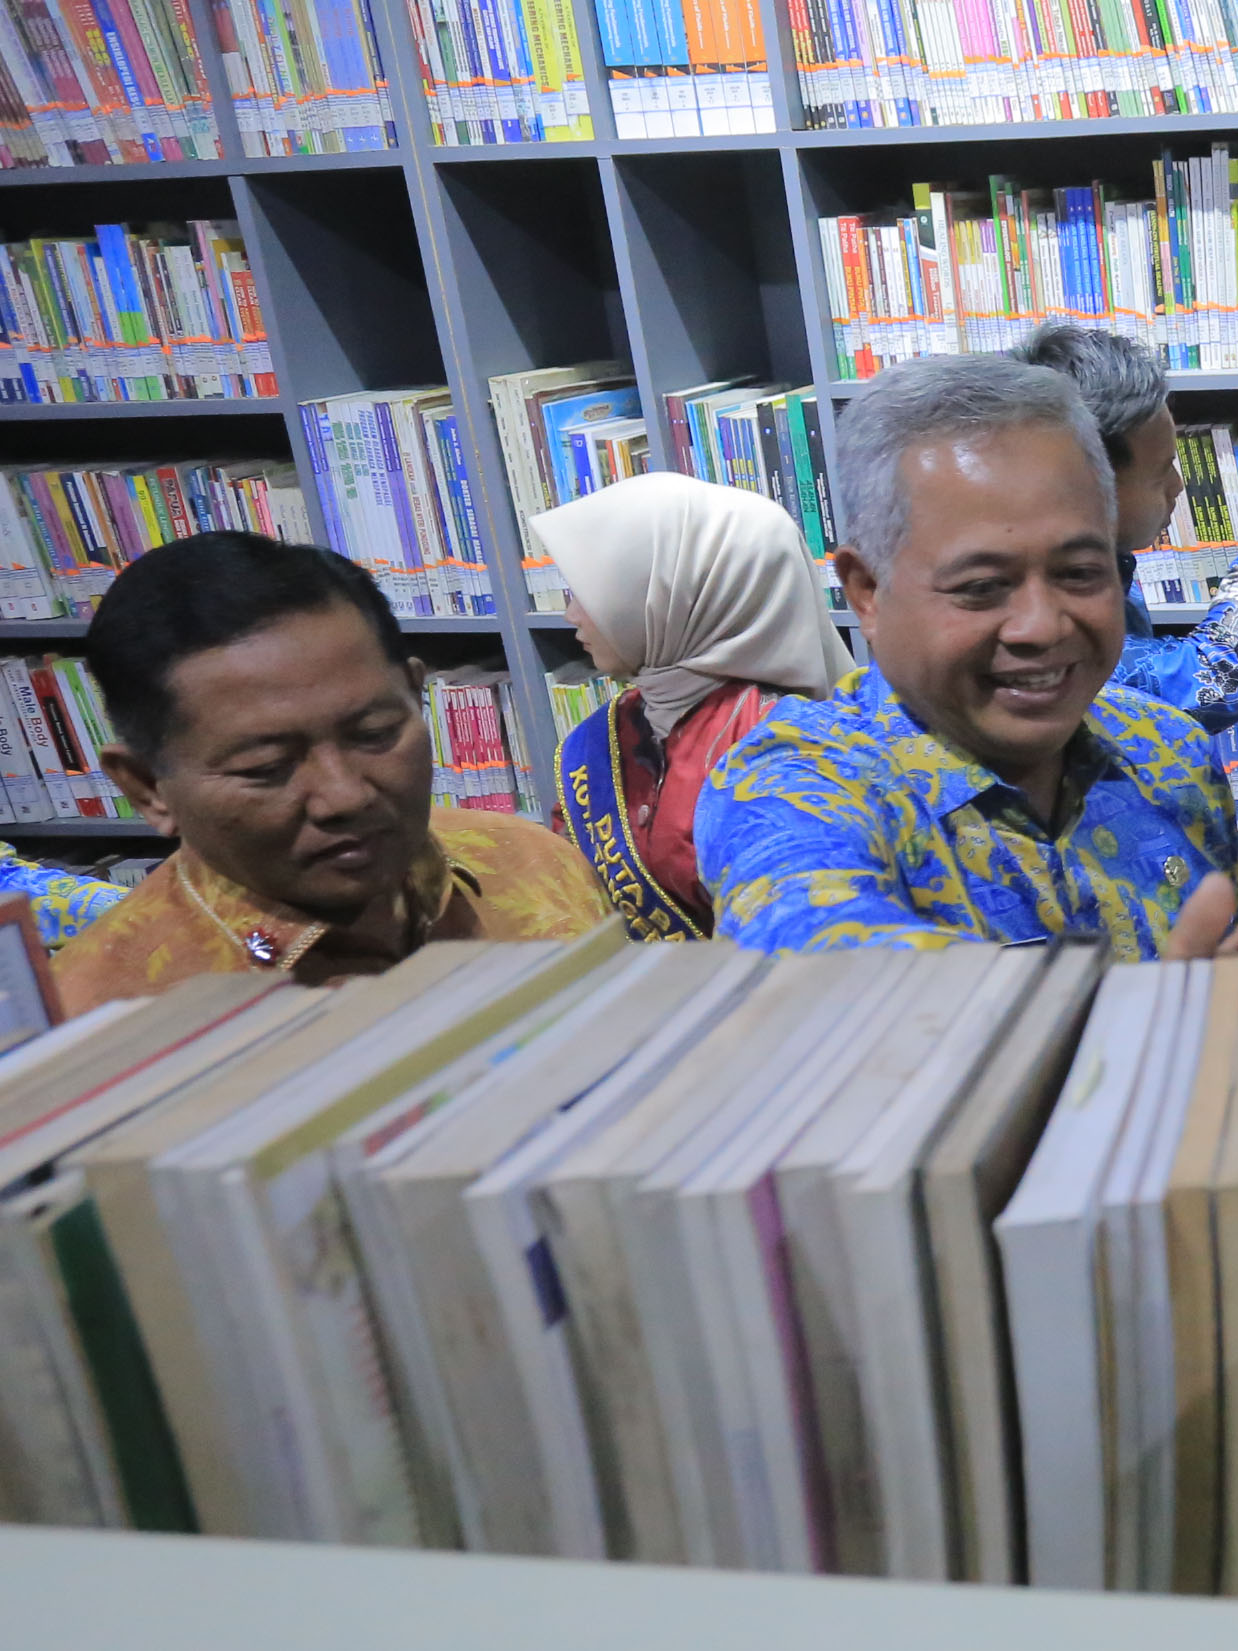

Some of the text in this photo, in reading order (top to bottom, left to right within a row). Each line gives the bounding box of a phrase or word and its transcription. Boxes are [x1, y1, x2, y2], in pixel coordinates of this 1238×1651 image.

[532, 34, 549, 87] MECHANICS
[460, 480, 484, 565] DOKTER SEBAGAI MANAJ
[0, 729, 13, 756] Body
[19, 686, 36, 714] Male
[31, 717, 49, 748] Body
[595, 812, 643, 908] DUTA
